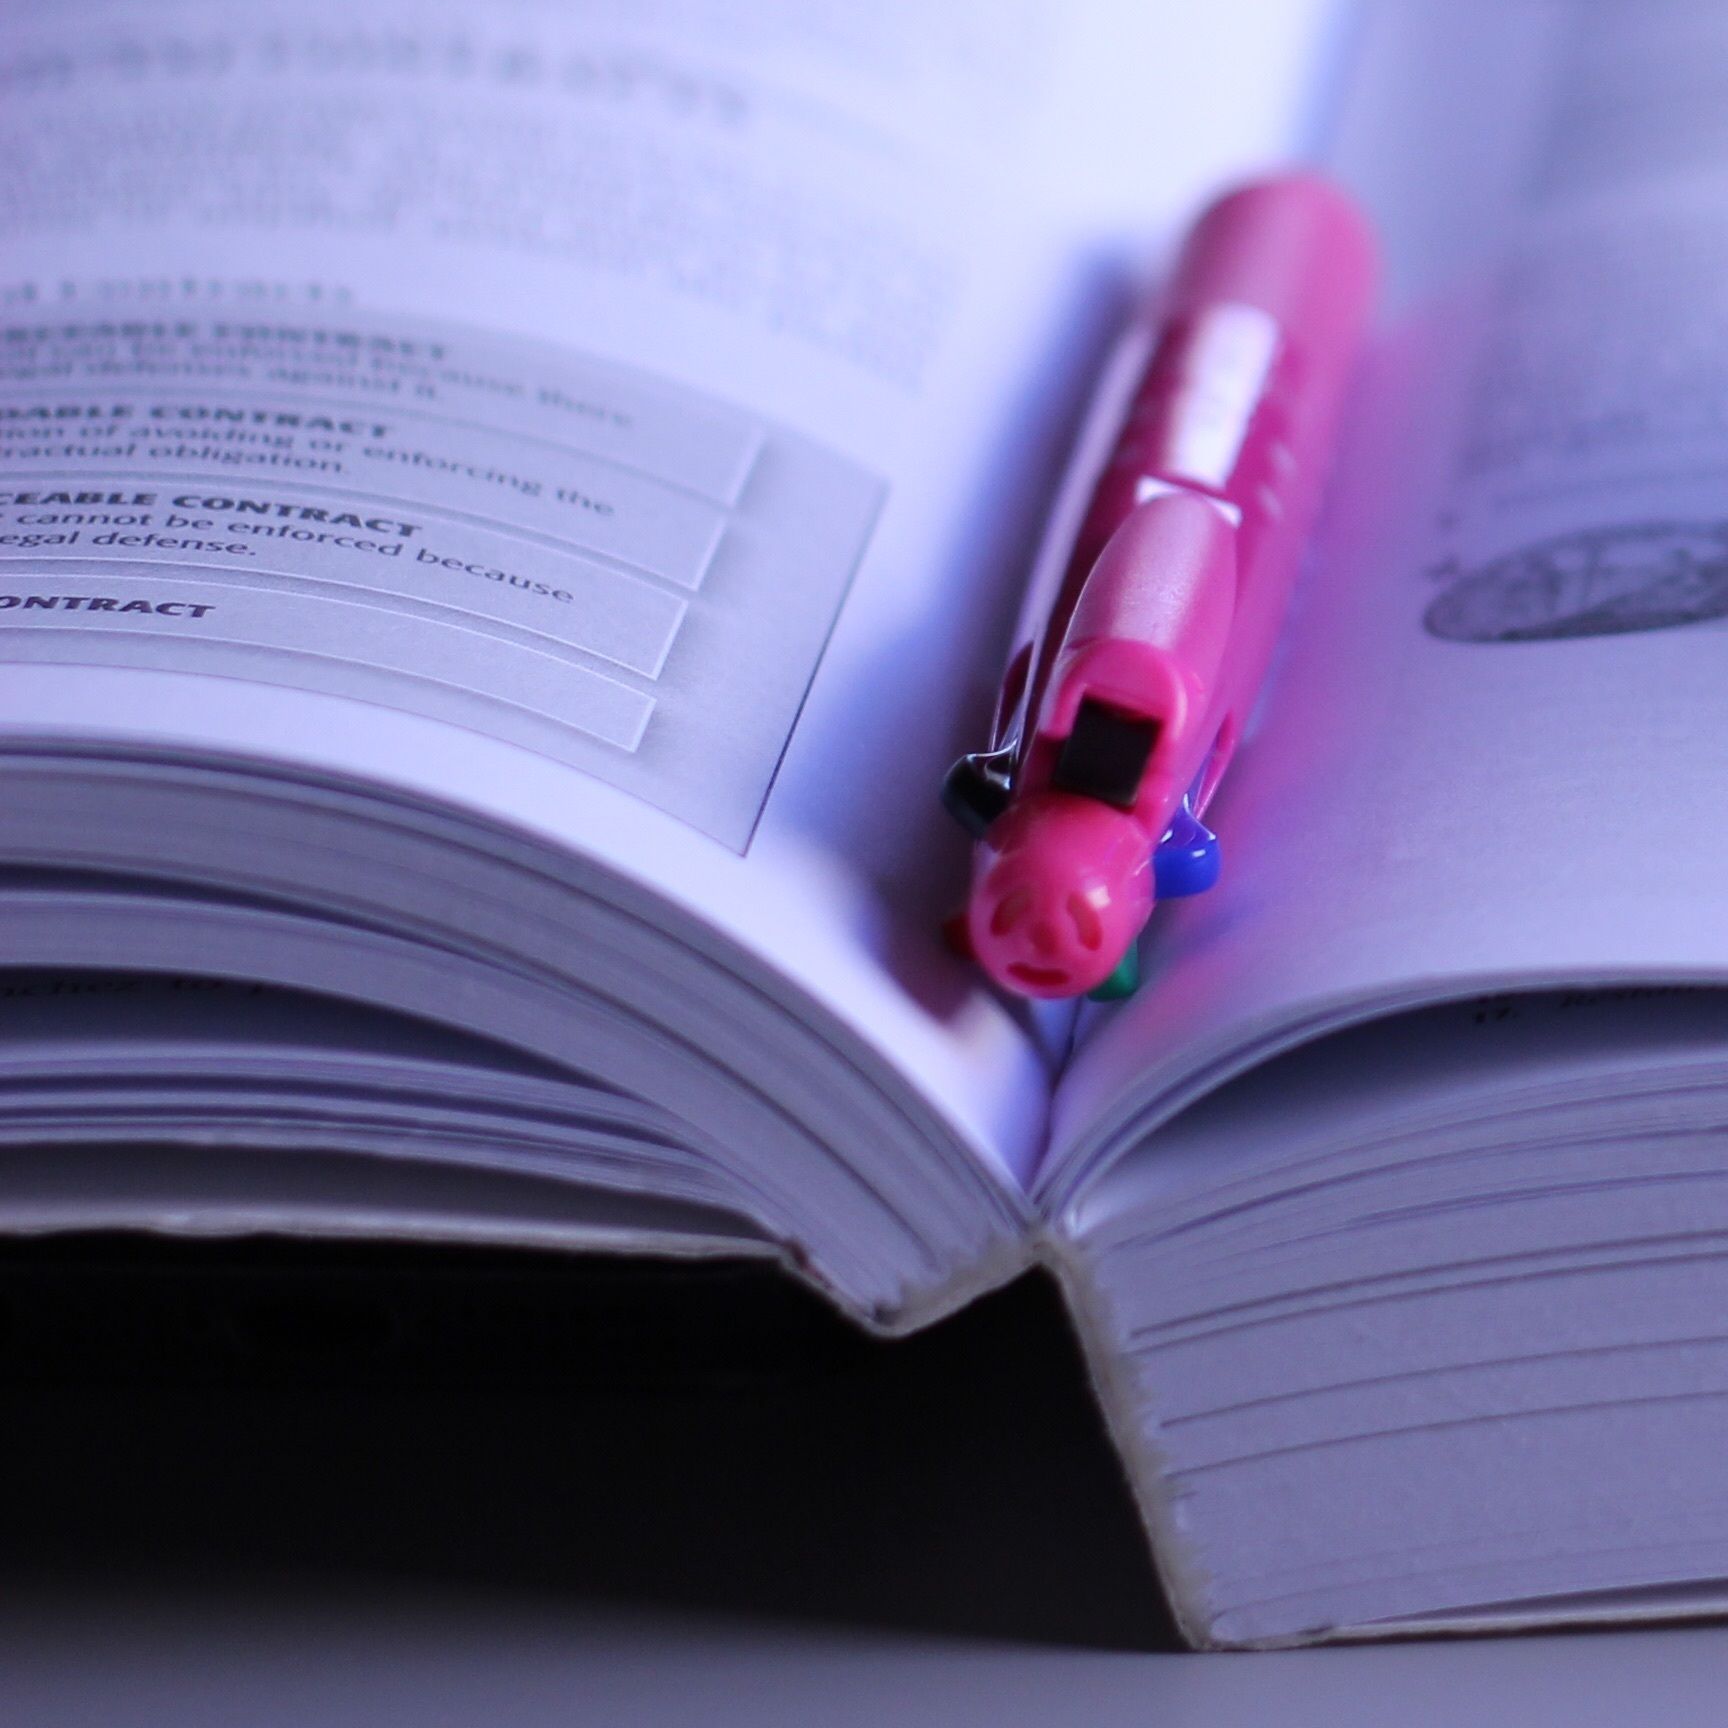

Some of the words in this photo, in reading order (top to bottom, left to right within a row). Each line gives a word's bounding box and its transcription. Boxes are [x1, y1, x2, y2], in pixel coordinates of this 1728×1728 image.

[149, 404, 392, 439] CONTRACT
[171, 494, 423, 539] CONTRACT
[16, 513, 154, 527] cannot
[164, 513, 215, 531] be
[227, 521, 404, 557] enforced
[415, 547, 575, 604] because
[91, 530, 258, 557] defense.
